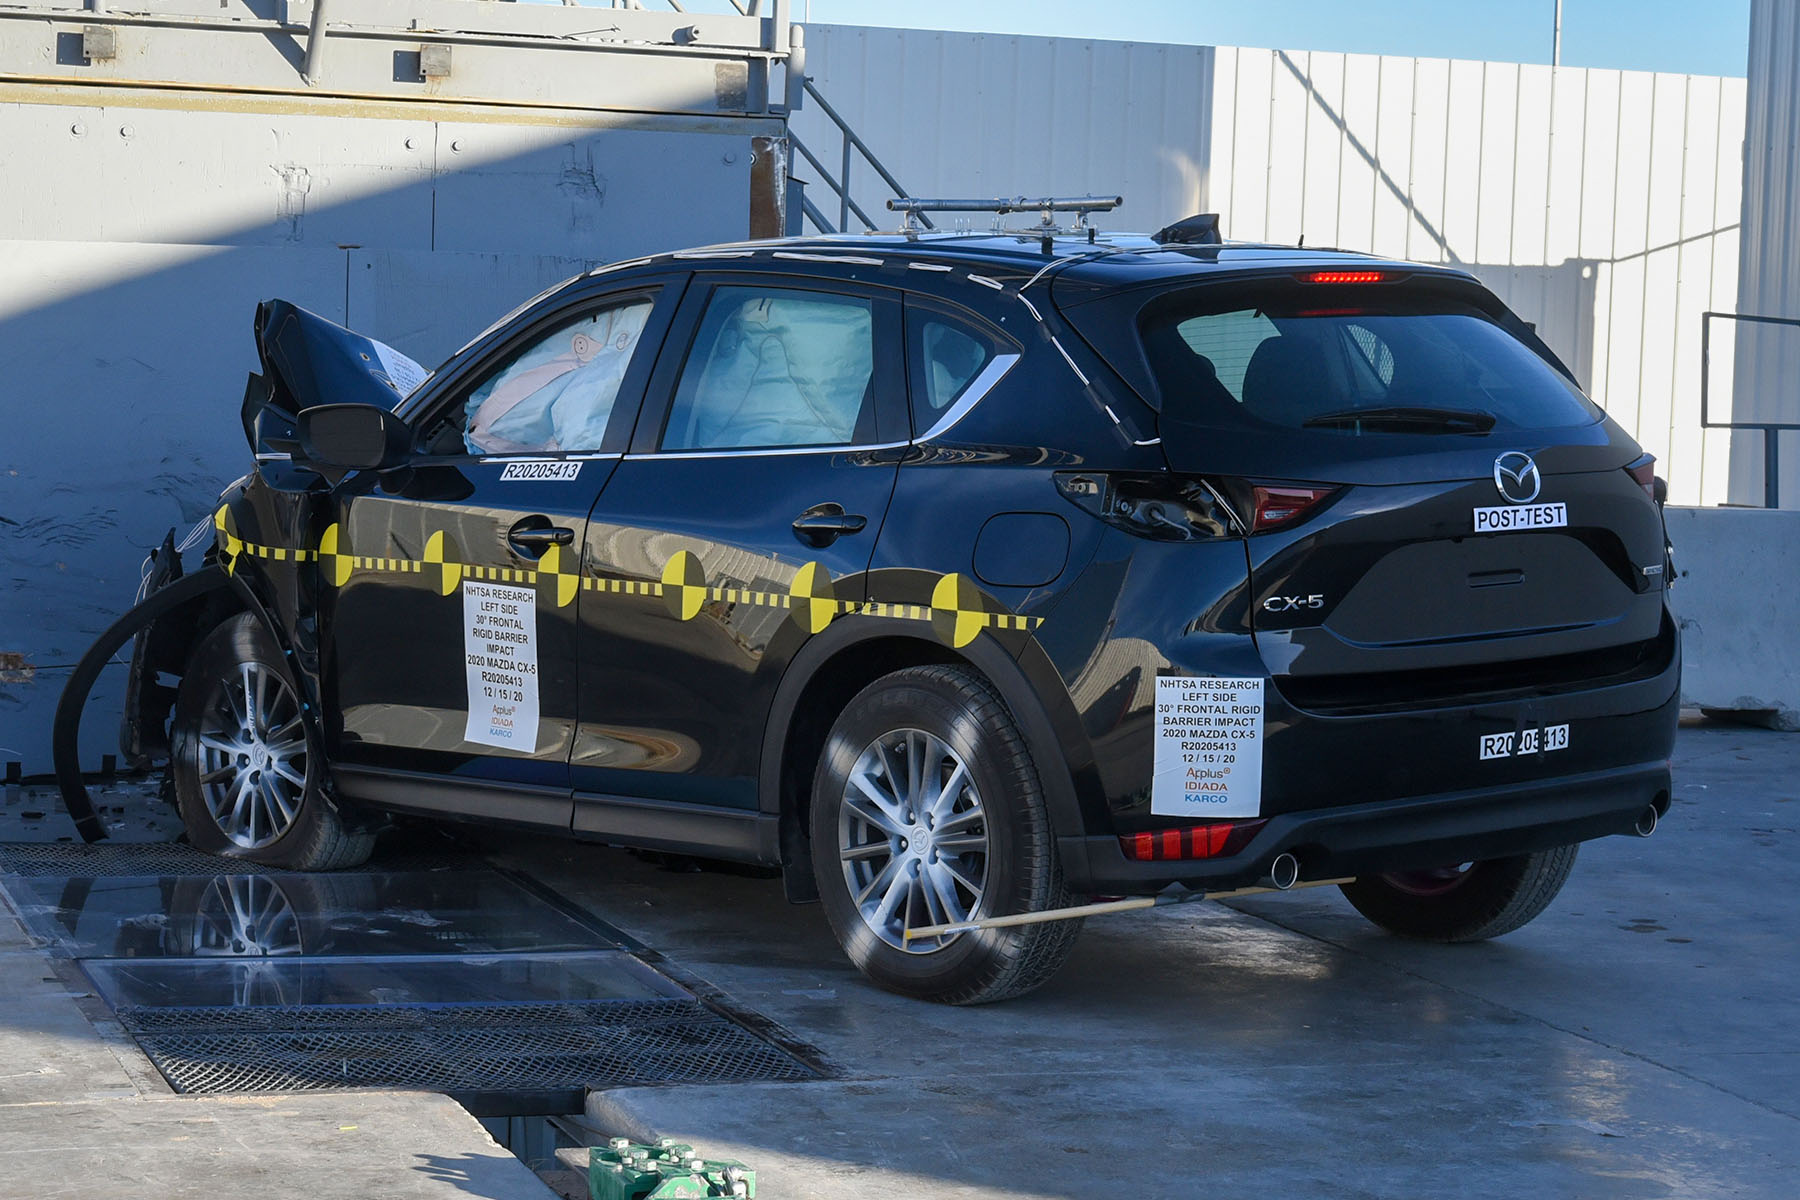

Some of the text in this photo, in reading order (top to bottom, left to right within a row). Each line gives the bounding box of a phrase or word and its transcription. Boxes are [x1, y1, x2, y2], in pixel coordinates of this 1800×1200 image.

[504, 463, 578, 479] R20205413
[1478, 506, 1564, 528] POST-TEST
[465, 585, 534, 603] NHTSA RESEARCH
[480, 601, 518, 616] LEFT SIDE
[1263, 594, 1325, 612] CX-5
[488, 616, 524, 630] FRONTAL
[472, 627, 528, 645] RIGID BARRIER
[486, 643, 515, 657] IMPACT
[467, 654, 536, 675] 2020 MAZDA CX-5
[481, 671, 523, 688] R20205413
[1160, 680, 1260, 690] NHTSA RESEARCH
[483, 686, 493, 698] 12
[498, 688, 508, 700] 15
[513, 690, 523, 702] 20
[1182, 692, 1237, 702] LEFT SIDE
[1177, 704, 1228, 714] FRONTAL
[1231, 705, 1261, 715] RIGID
[1163, 716, 1256, 727] BARRIER IMPACT
[489, 728, 512, 739] KARCO
[1162, 728, 1256, 739] 2020 MAZDA CX-5
[1181, 741, 1237, 751] R20205413
[1182, 754, 1194, 763] 12
[1203, 754, 1215, 763] 15
[1223, 754, 1236, 764] 20
[1185, 781, 1228, 791] IDIADA
[1184, 793, 1228, 804] KARCO
